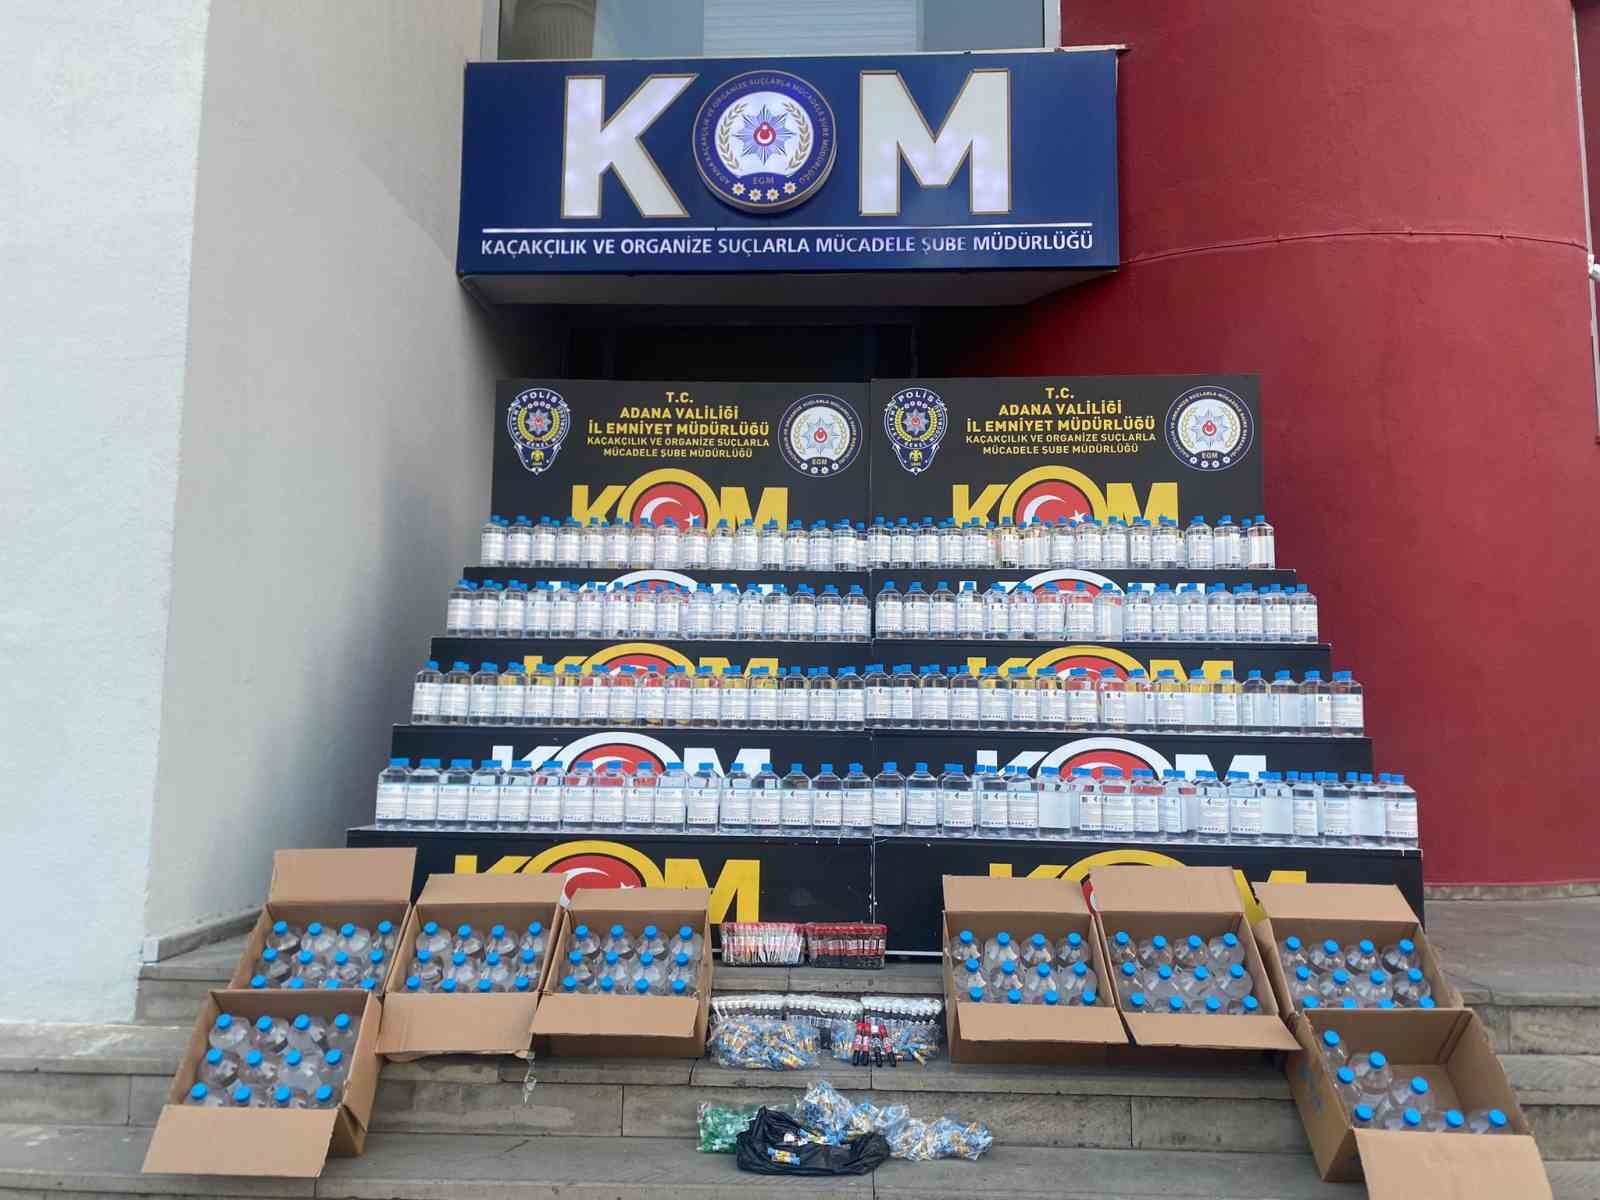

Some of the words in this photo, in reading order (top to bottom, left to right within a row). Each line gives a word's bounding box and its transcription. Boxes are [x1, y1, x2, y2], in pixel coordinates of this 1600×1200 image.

[481, 239, 587, 259] KAÇAKÇILIK
[593, 239, 615, 254] VE
[620, 235, 712, 254] ORGANİZE
[718, 237, 809, 256] SUÇLARLA
[816, 234, 915, 252] MÜCADELE
[922, 236, 967, 255] ŞUBE
[974, 230, 1093, 250] MÜDÜRLÜĞÜ
[666, 391, 694, 403] T.C.
[1045, 387, 1075, 399] T.C.
[620, 407, 672, 419] ADANA
[675, 405, 739, 420] VALİLİĞİ
[998, 404, 1052, 416] ADANA
[1055, 400, 1121, 415] VALİLİĞİ
[588, 419, 603, 434] İL
[606, 421, 672, 435] EMNİYET
[677, 421, 769, 436] MÜDÜRLÜĞÜ
[967, 418, 981, 433] İL
[985, 417, 1053, 432] EMNİYET
[1058, 416, 1155, 431] MÜDÜRLÜĞÜ
[587, 437, 648, 448] KAÇAKÇILIK
[650, 437, 662, 446] VE
[665, 437, 714, 447] ORGANİZE
[717, 438, 769, 448] SUÇLARLA
[966, 434, 1028, 445] KAÇAKÇILIK
[1031, 433, 1043, 442] VE
[1046, 432, 1098, 442] ORGANİZE
[603, 447, 658, 457] MÜCADELE
[983, 443, 1039, 454] MÜCADELE
